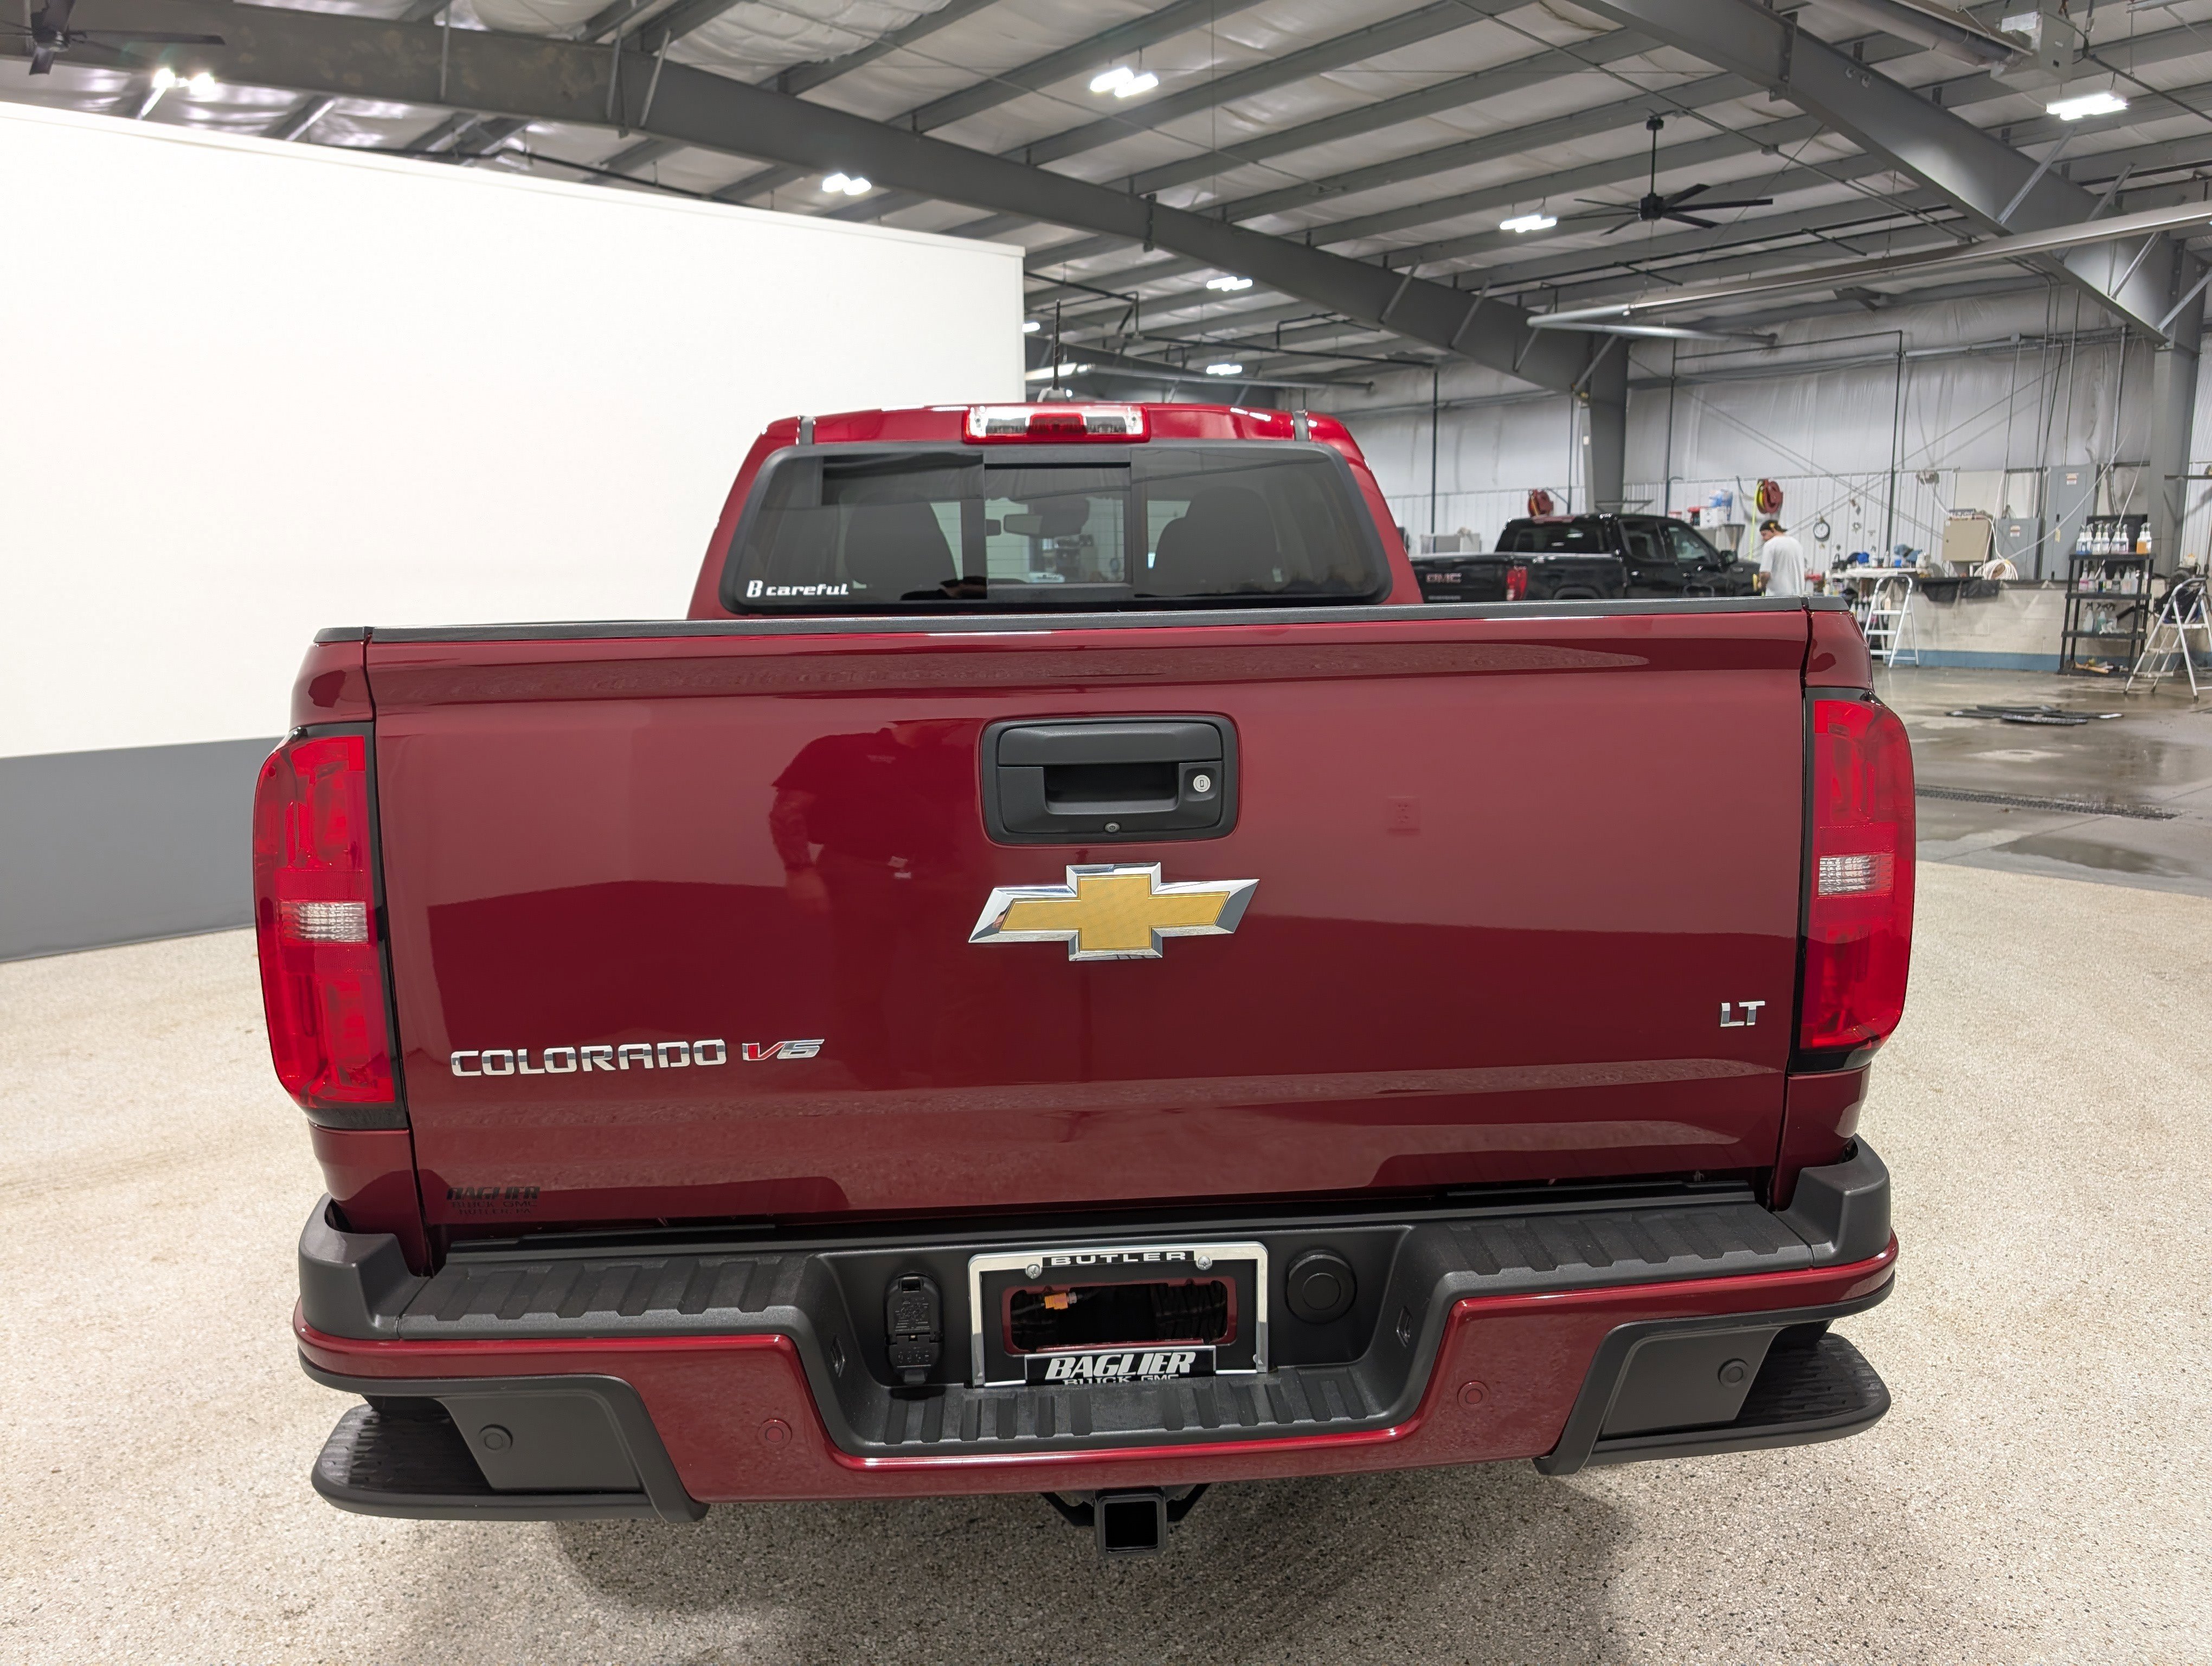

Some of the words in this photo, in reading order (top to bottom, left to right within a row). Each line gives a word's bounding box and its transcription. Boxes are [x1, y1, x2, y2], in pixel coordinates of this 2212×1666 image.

[746, 580, 763, 598] B
[766, 583, 849, 596] careful
[1720, 1001, 1765, 1027] LT
[451, 1039, 727, 1077] COLORADO
[742, 1039, 825, 1061] V6
[1051, 1252, 1186, 1266] BUTLER
[1045, 1351, 1197, 1380] BAGLIER
